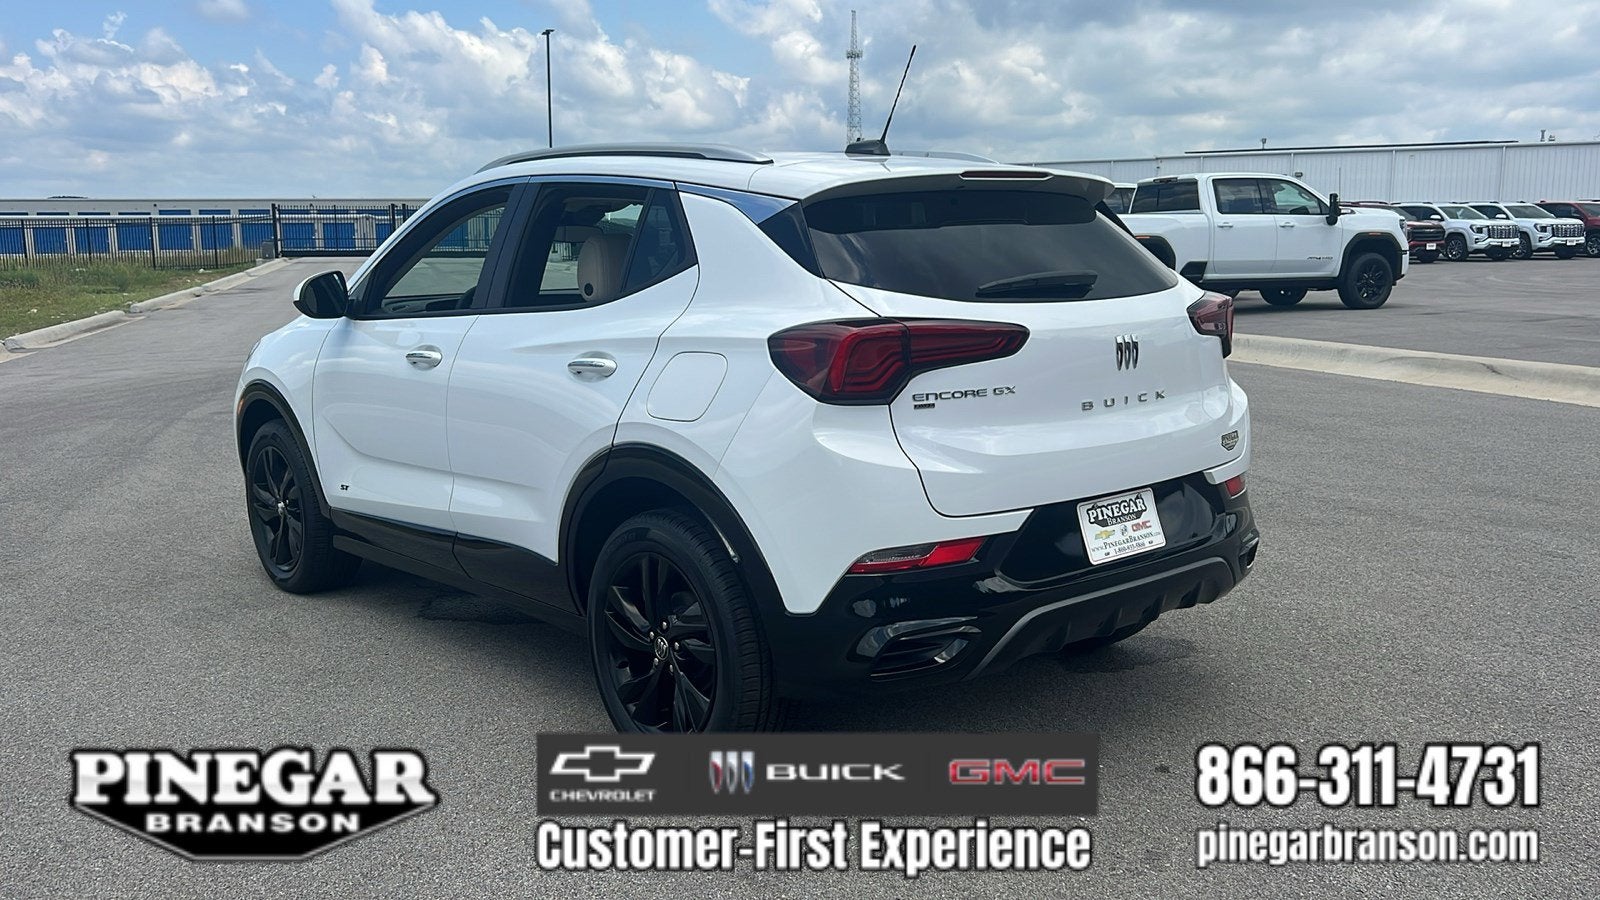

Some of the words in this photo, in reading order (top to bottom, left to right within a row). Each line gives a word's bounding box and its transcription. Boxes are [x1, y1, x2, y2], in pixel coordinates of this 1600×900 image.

[911, 388, 988, 402] ENCORE
[993, 385, 1016, 396] GX
[1081, 390, 1166, 411] BUICK
[1087, 498, 1146, 523] PINEGAR
[1131, 520, 1152, 532] GMC
